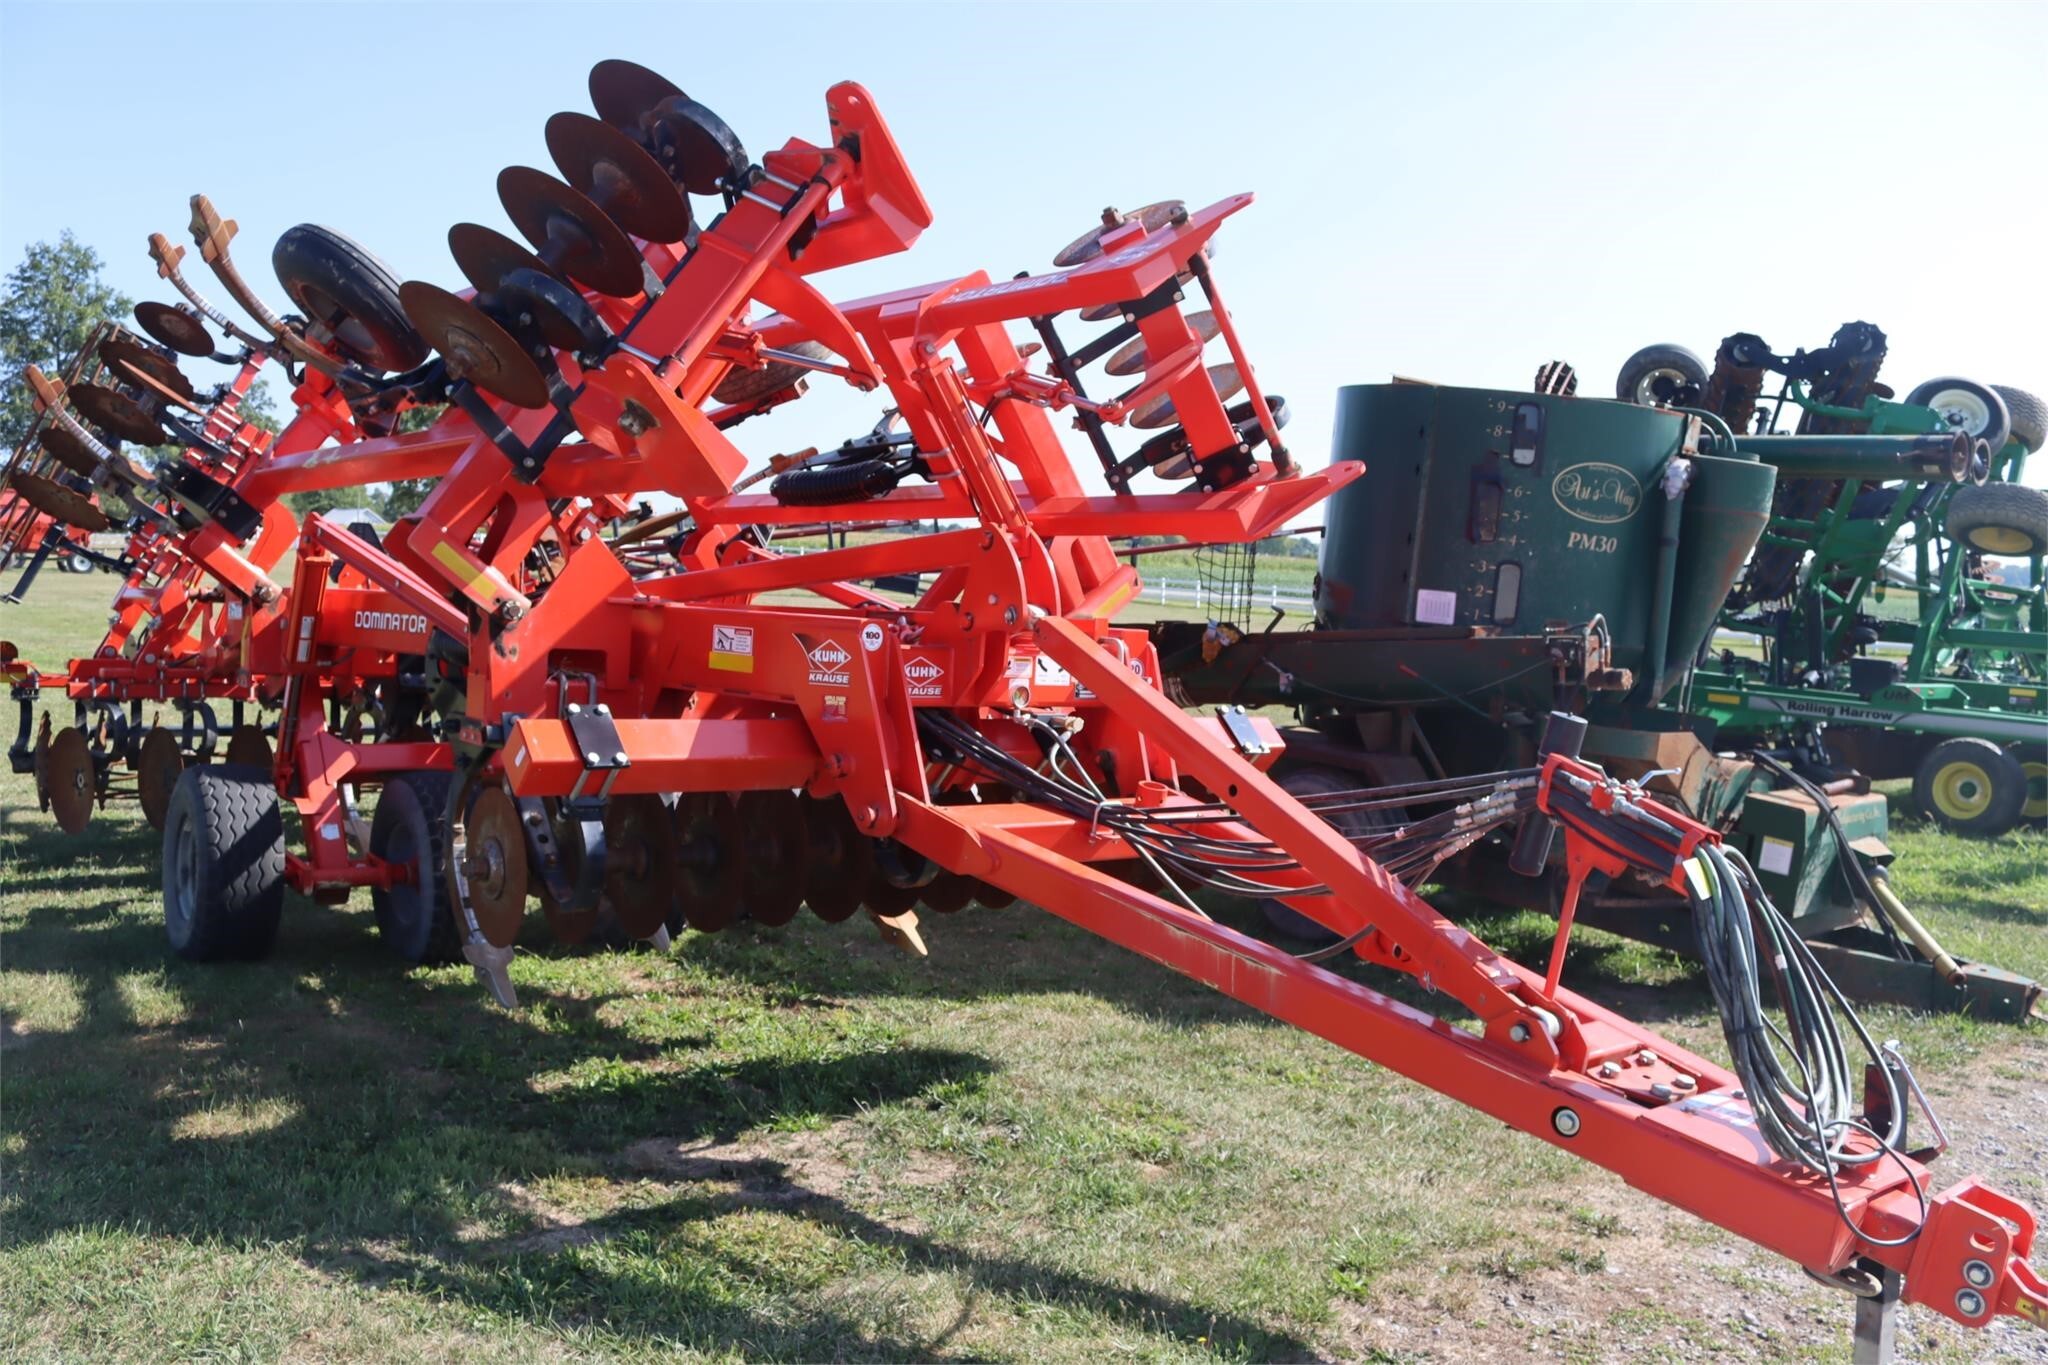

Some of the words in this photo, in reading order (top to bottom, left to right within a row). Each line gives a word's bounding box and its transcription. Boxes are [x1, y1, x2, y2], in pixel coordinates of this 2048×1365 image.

[1493, 424, 1503, 437] 8
[1513, 485, 1523, 498] 6
[1511, 510, 1521, 523] 5
[1567, 531, 1618, 554] PM30
[1477, 560, 1488, 573] 3
[1474, 584, 1485, 598] 2
[354, 611, 428, 633] DOMINATOR
[814, 650, 845, 663] KUHN
[808, 672, 849, 684] KRAUSE
[1786, 700, 1836, 717] Rolling
[1839, 706, 1894, 721] Harrow
